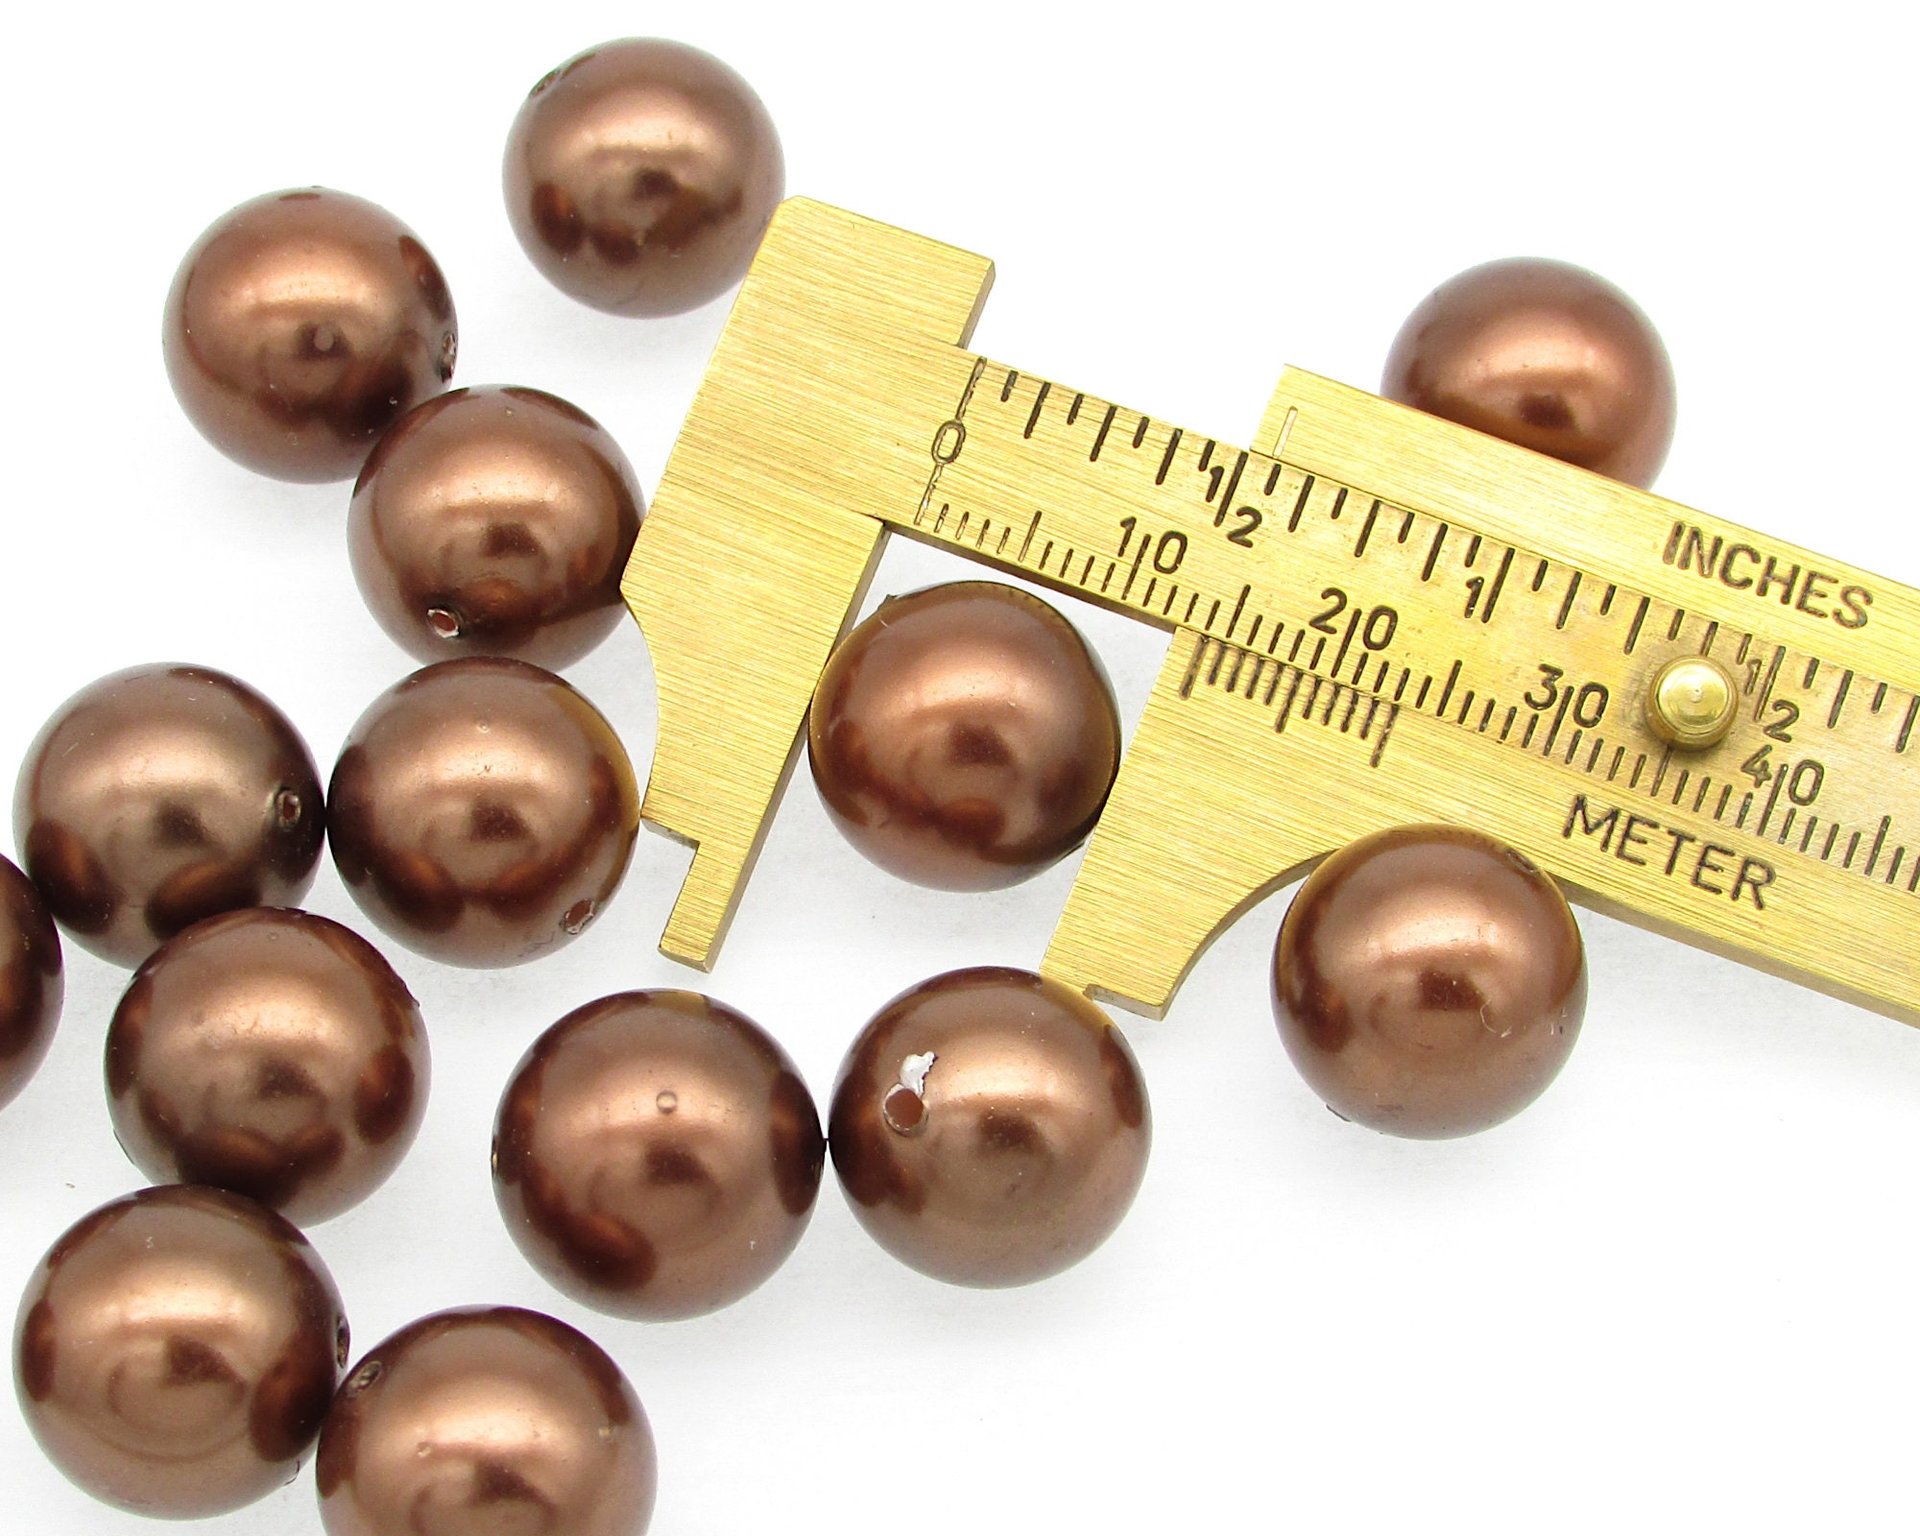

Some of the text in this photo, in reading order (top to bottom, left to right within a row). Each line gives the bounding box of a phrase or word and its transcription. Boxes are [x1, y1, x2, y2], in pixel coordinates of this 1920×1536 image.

[931, 420, 966, 464] 0
[1464, 576, 1485, 619] 1
[1662, 521, 1874, 630] INCHES
[1562, 794, 1777, 911] METER
